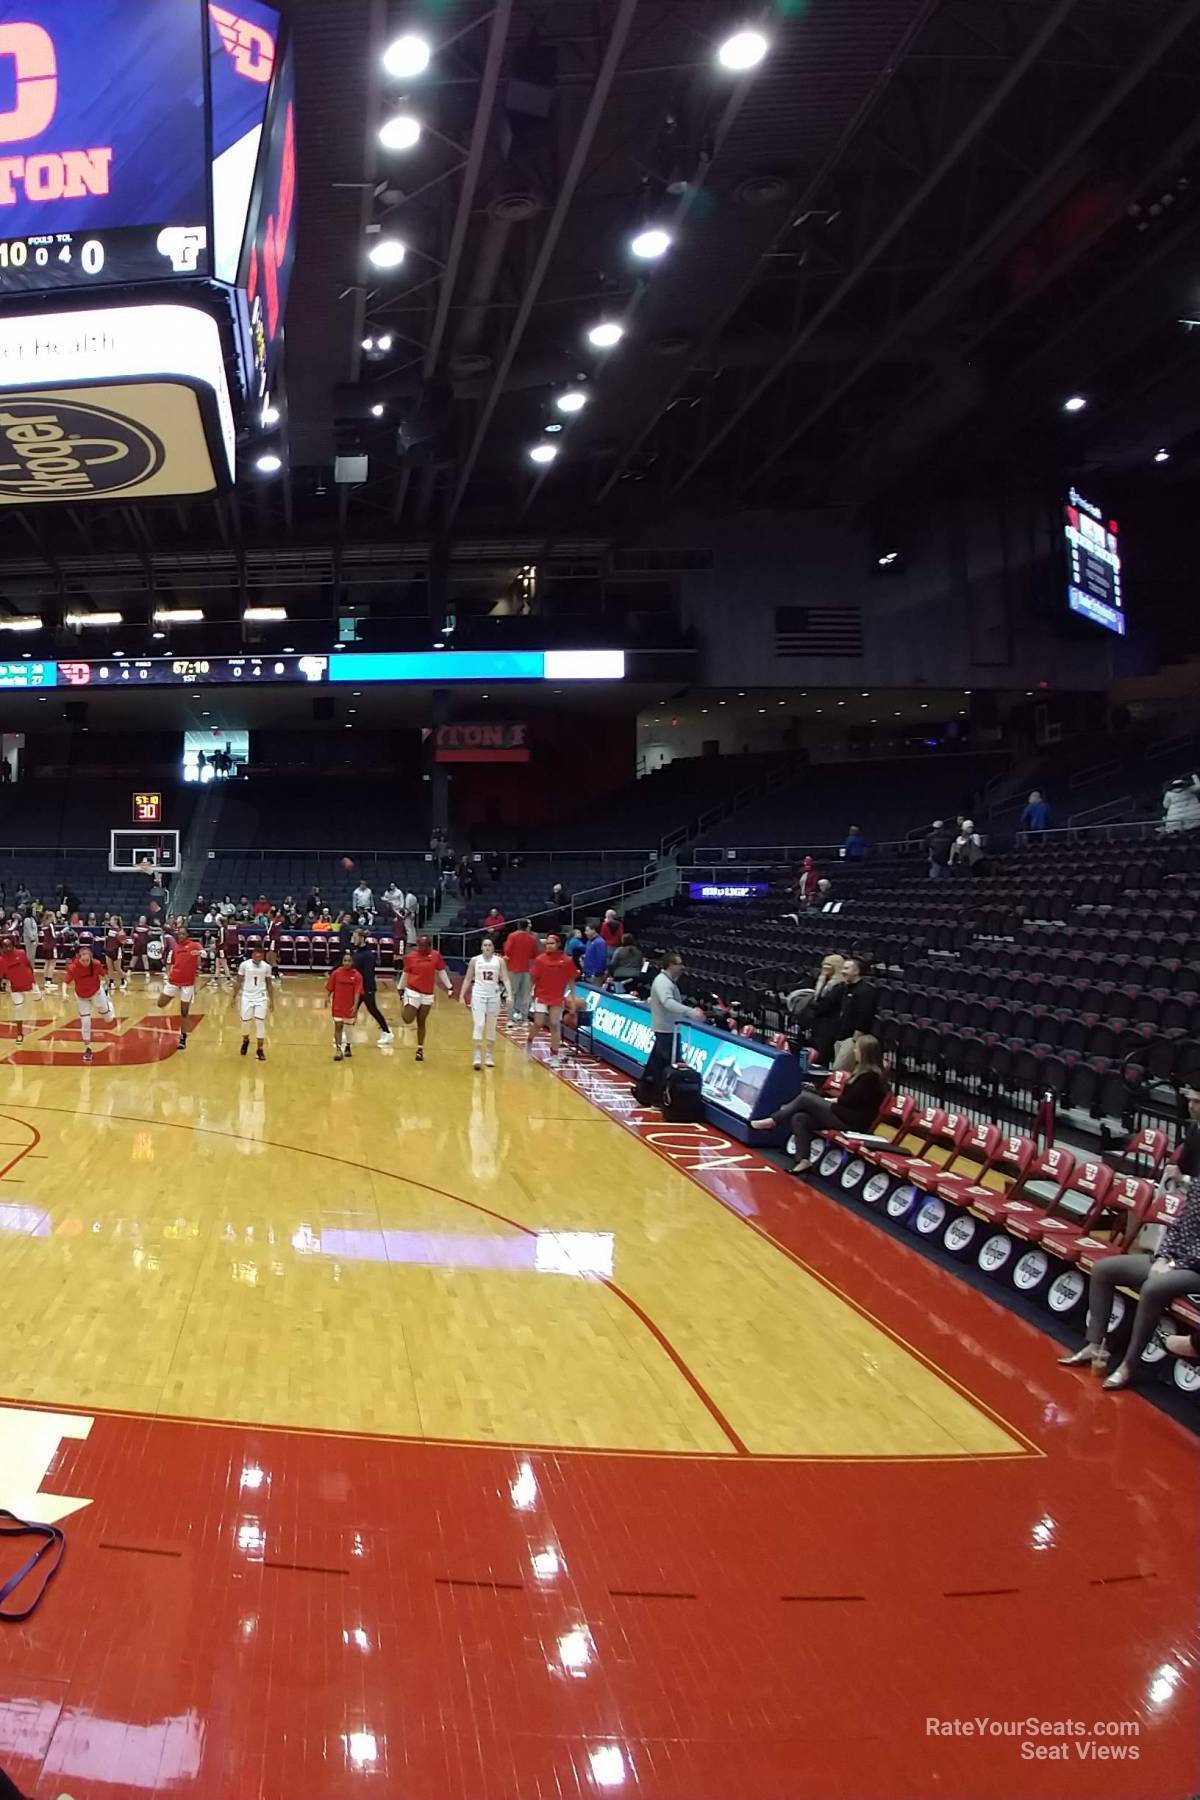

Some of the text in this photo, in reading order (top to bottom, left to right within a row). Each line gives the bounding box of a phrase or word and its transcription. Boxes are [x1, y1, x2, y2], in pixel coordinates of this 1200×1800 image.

[35, 240, 105, 274] 0 4 0
[172, 661, 209, 674] 57:10
[138, 804, 156, 819] 30
[482, 971, 494, 981] 12
[593, 1007, 626, 1039] SENIOR
[620, 1018, 656, 1054] LIVING
